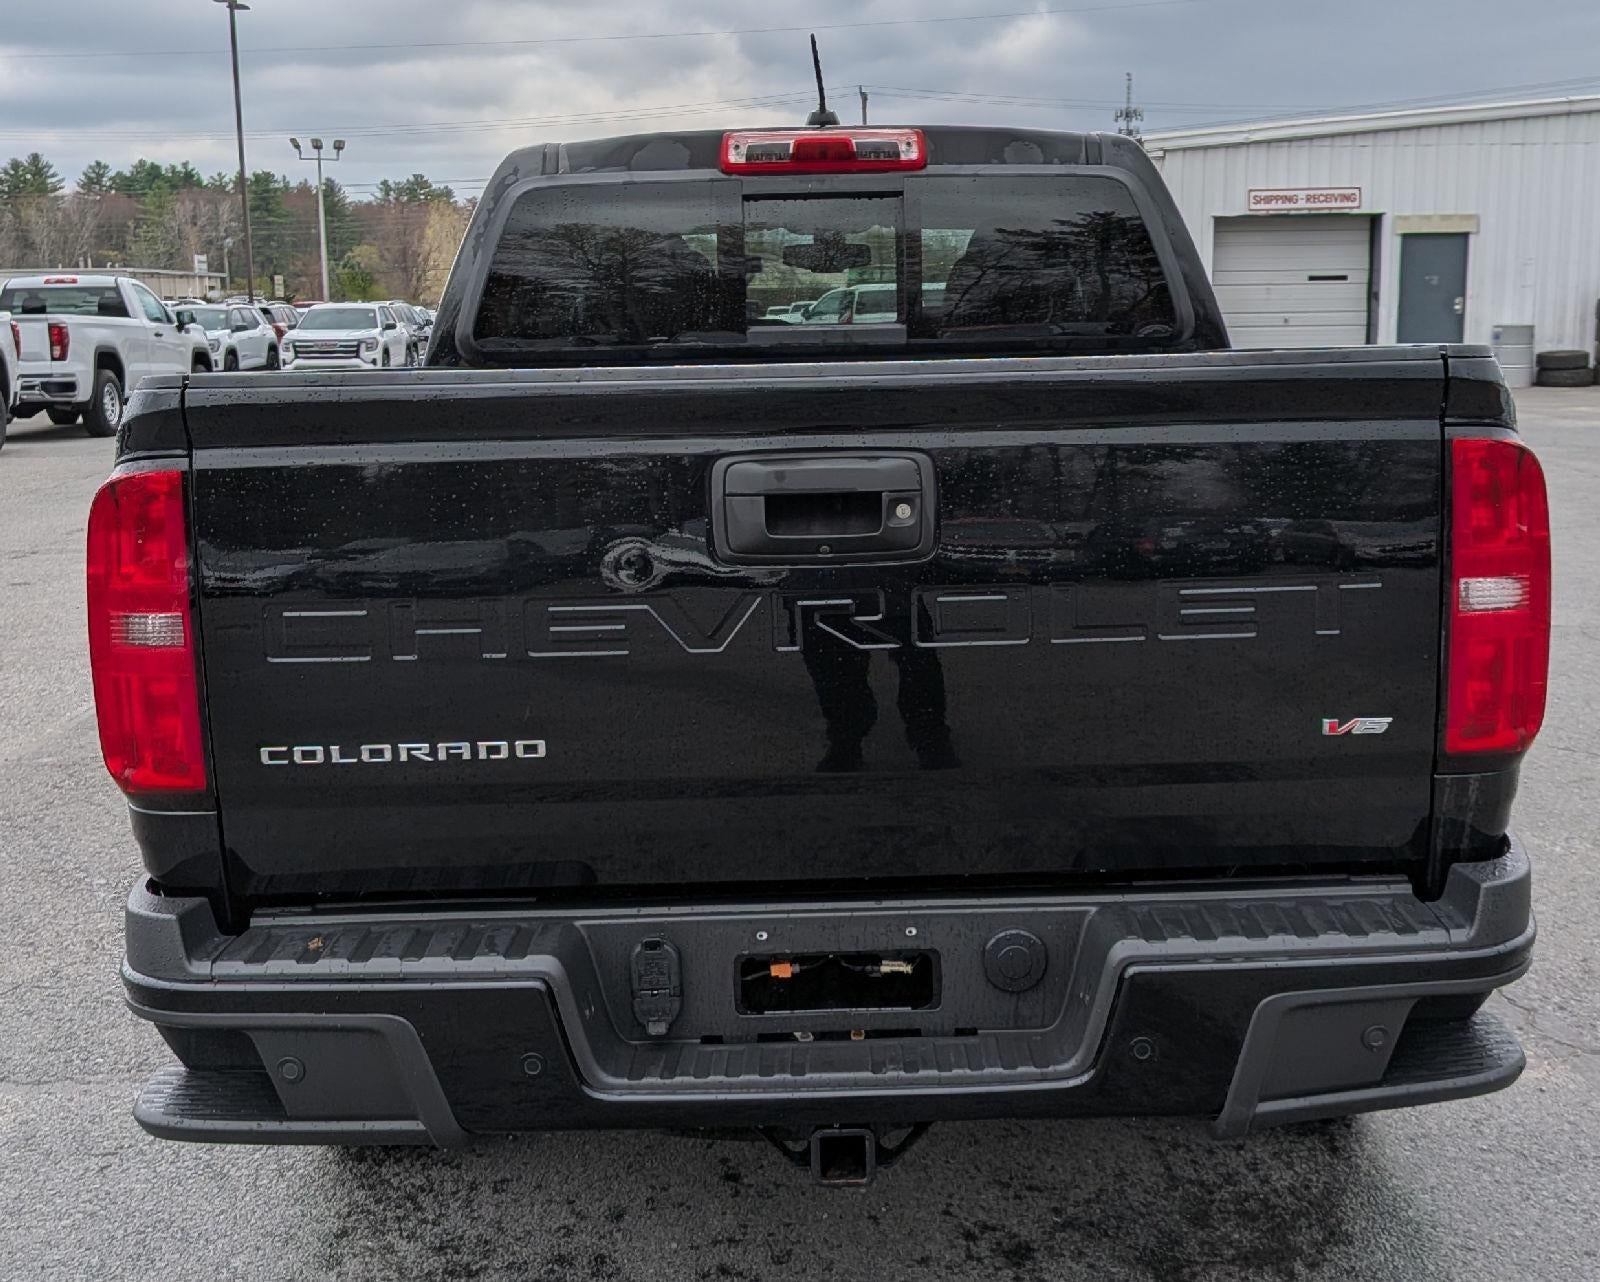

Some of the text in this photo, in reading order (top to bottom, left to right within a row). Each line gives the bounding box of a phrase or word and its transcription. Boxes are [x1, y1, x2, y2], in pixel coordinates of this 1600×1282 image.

[1252, 194, 1299, 205] SHIPPING
[1305, 193, 1357, 204] RECEIVING
[264, 581, 1383, 662] CHEVROLET
[1322, 717, 1393, 735] V6
[260, 739, 547, 765] COLORADO
